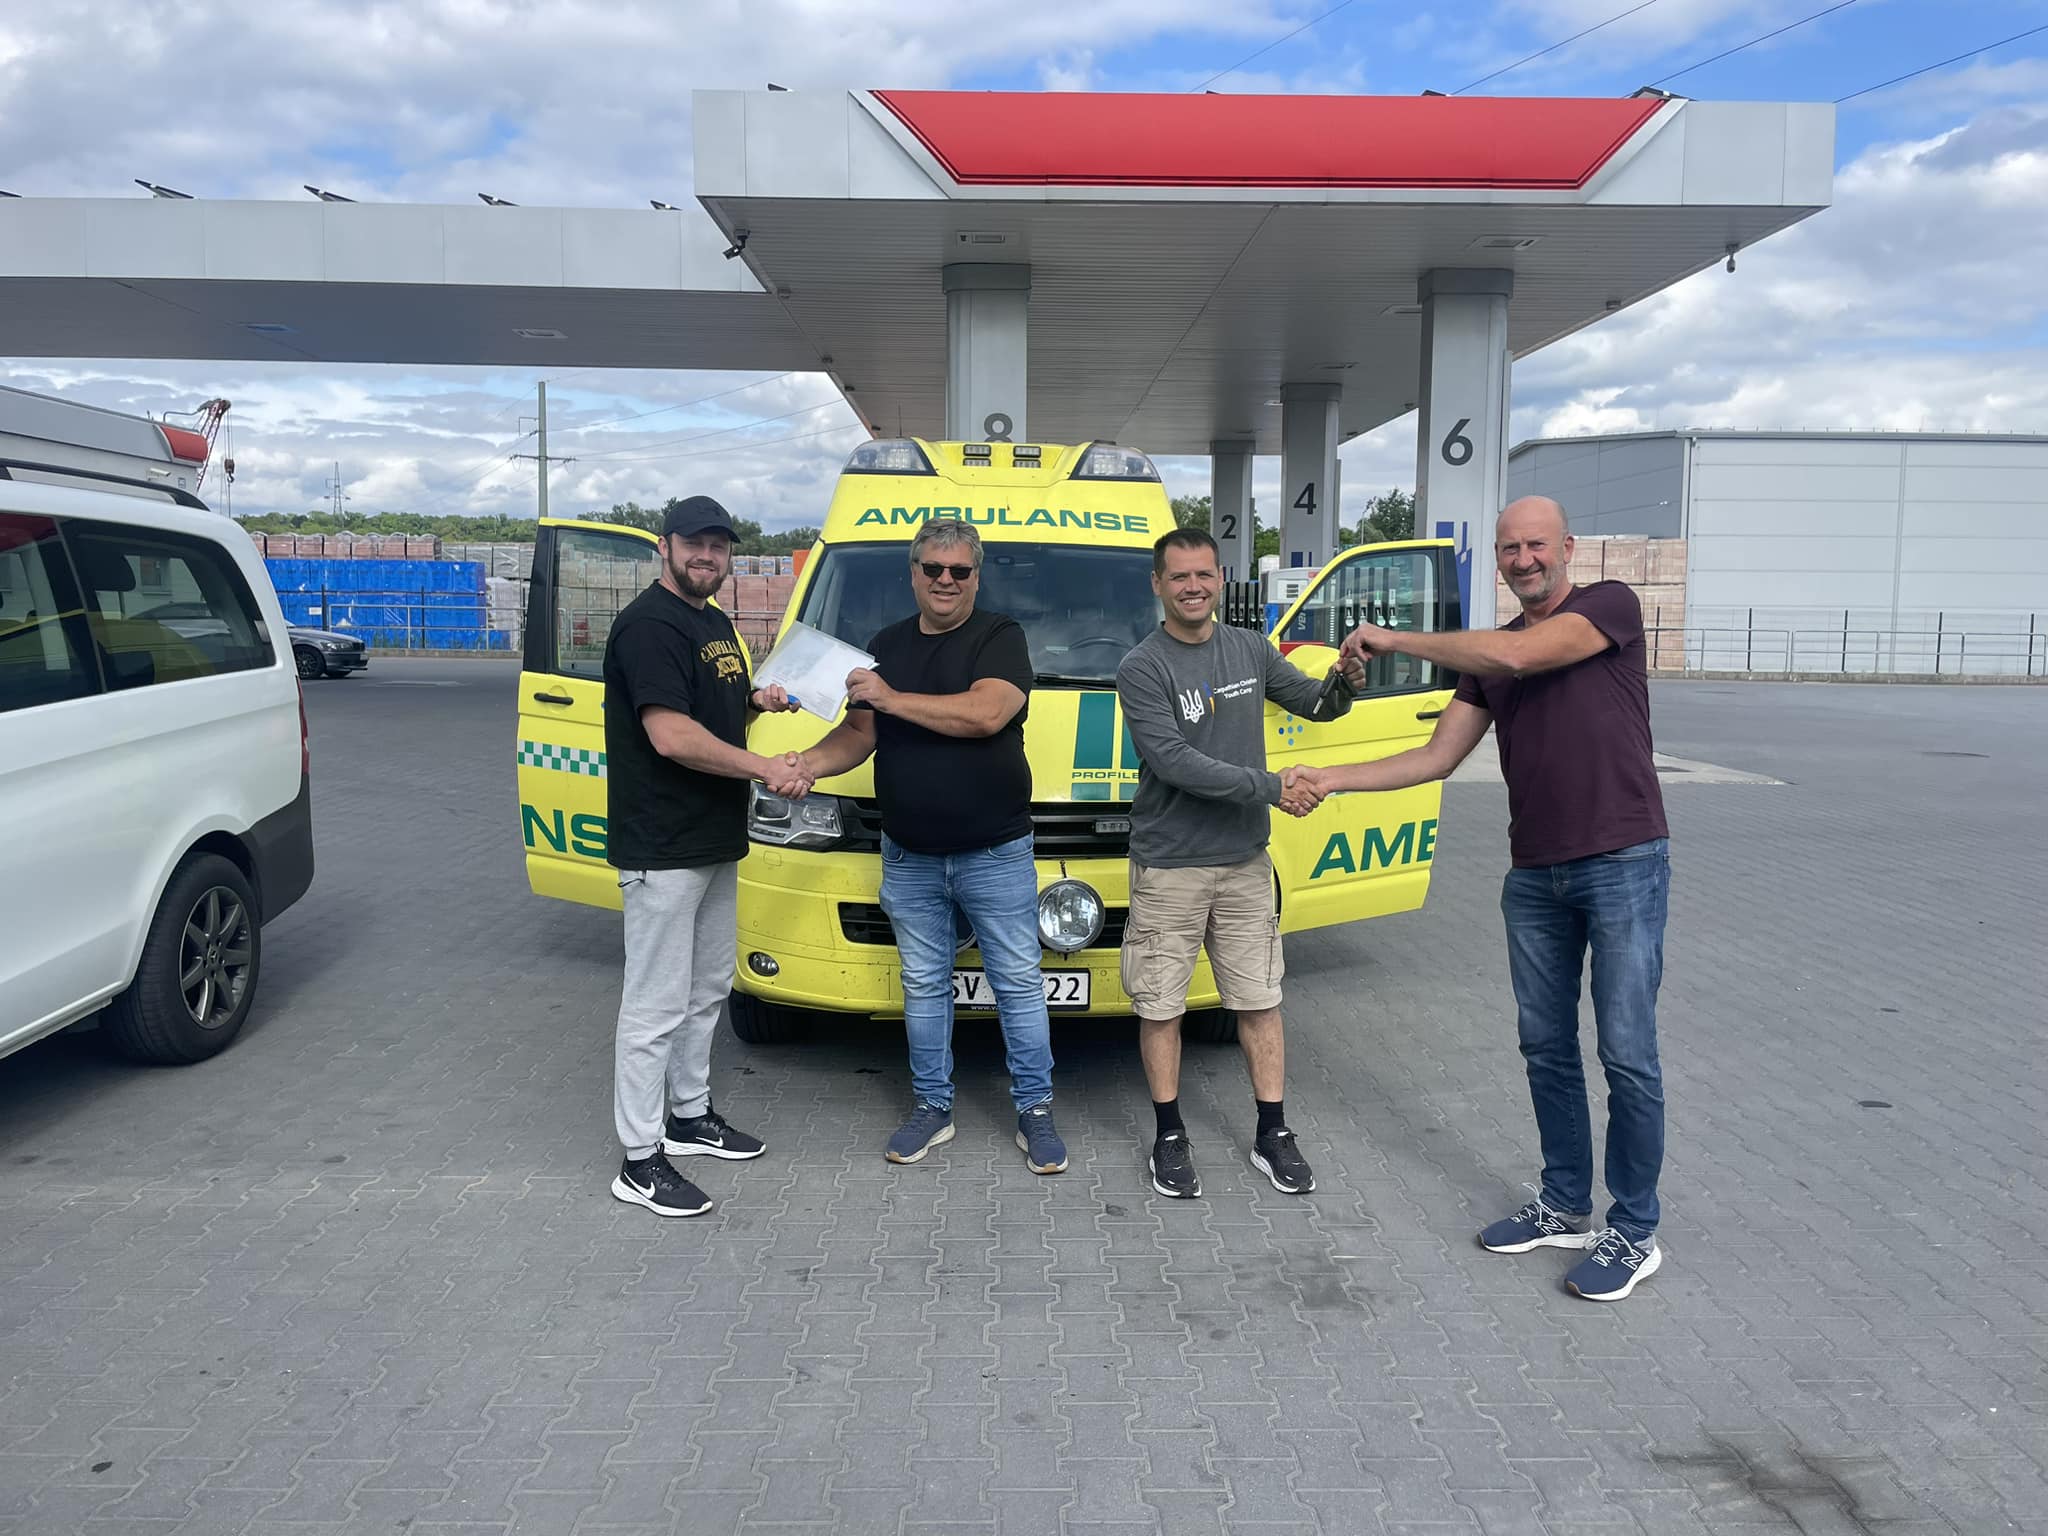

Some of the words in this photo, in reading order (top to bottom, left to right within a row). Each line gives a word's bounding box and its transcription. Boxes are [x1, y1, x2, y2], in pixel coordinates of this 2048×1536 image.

[1442, 418, 1473, 466] 6
[1293, 483, 1317, 515] 4
[855, 507, 1149, 533] AMBULANSE
[1221, 515, 1237, 540] 2
[1071, 771, 1140, 779] PROFILE
